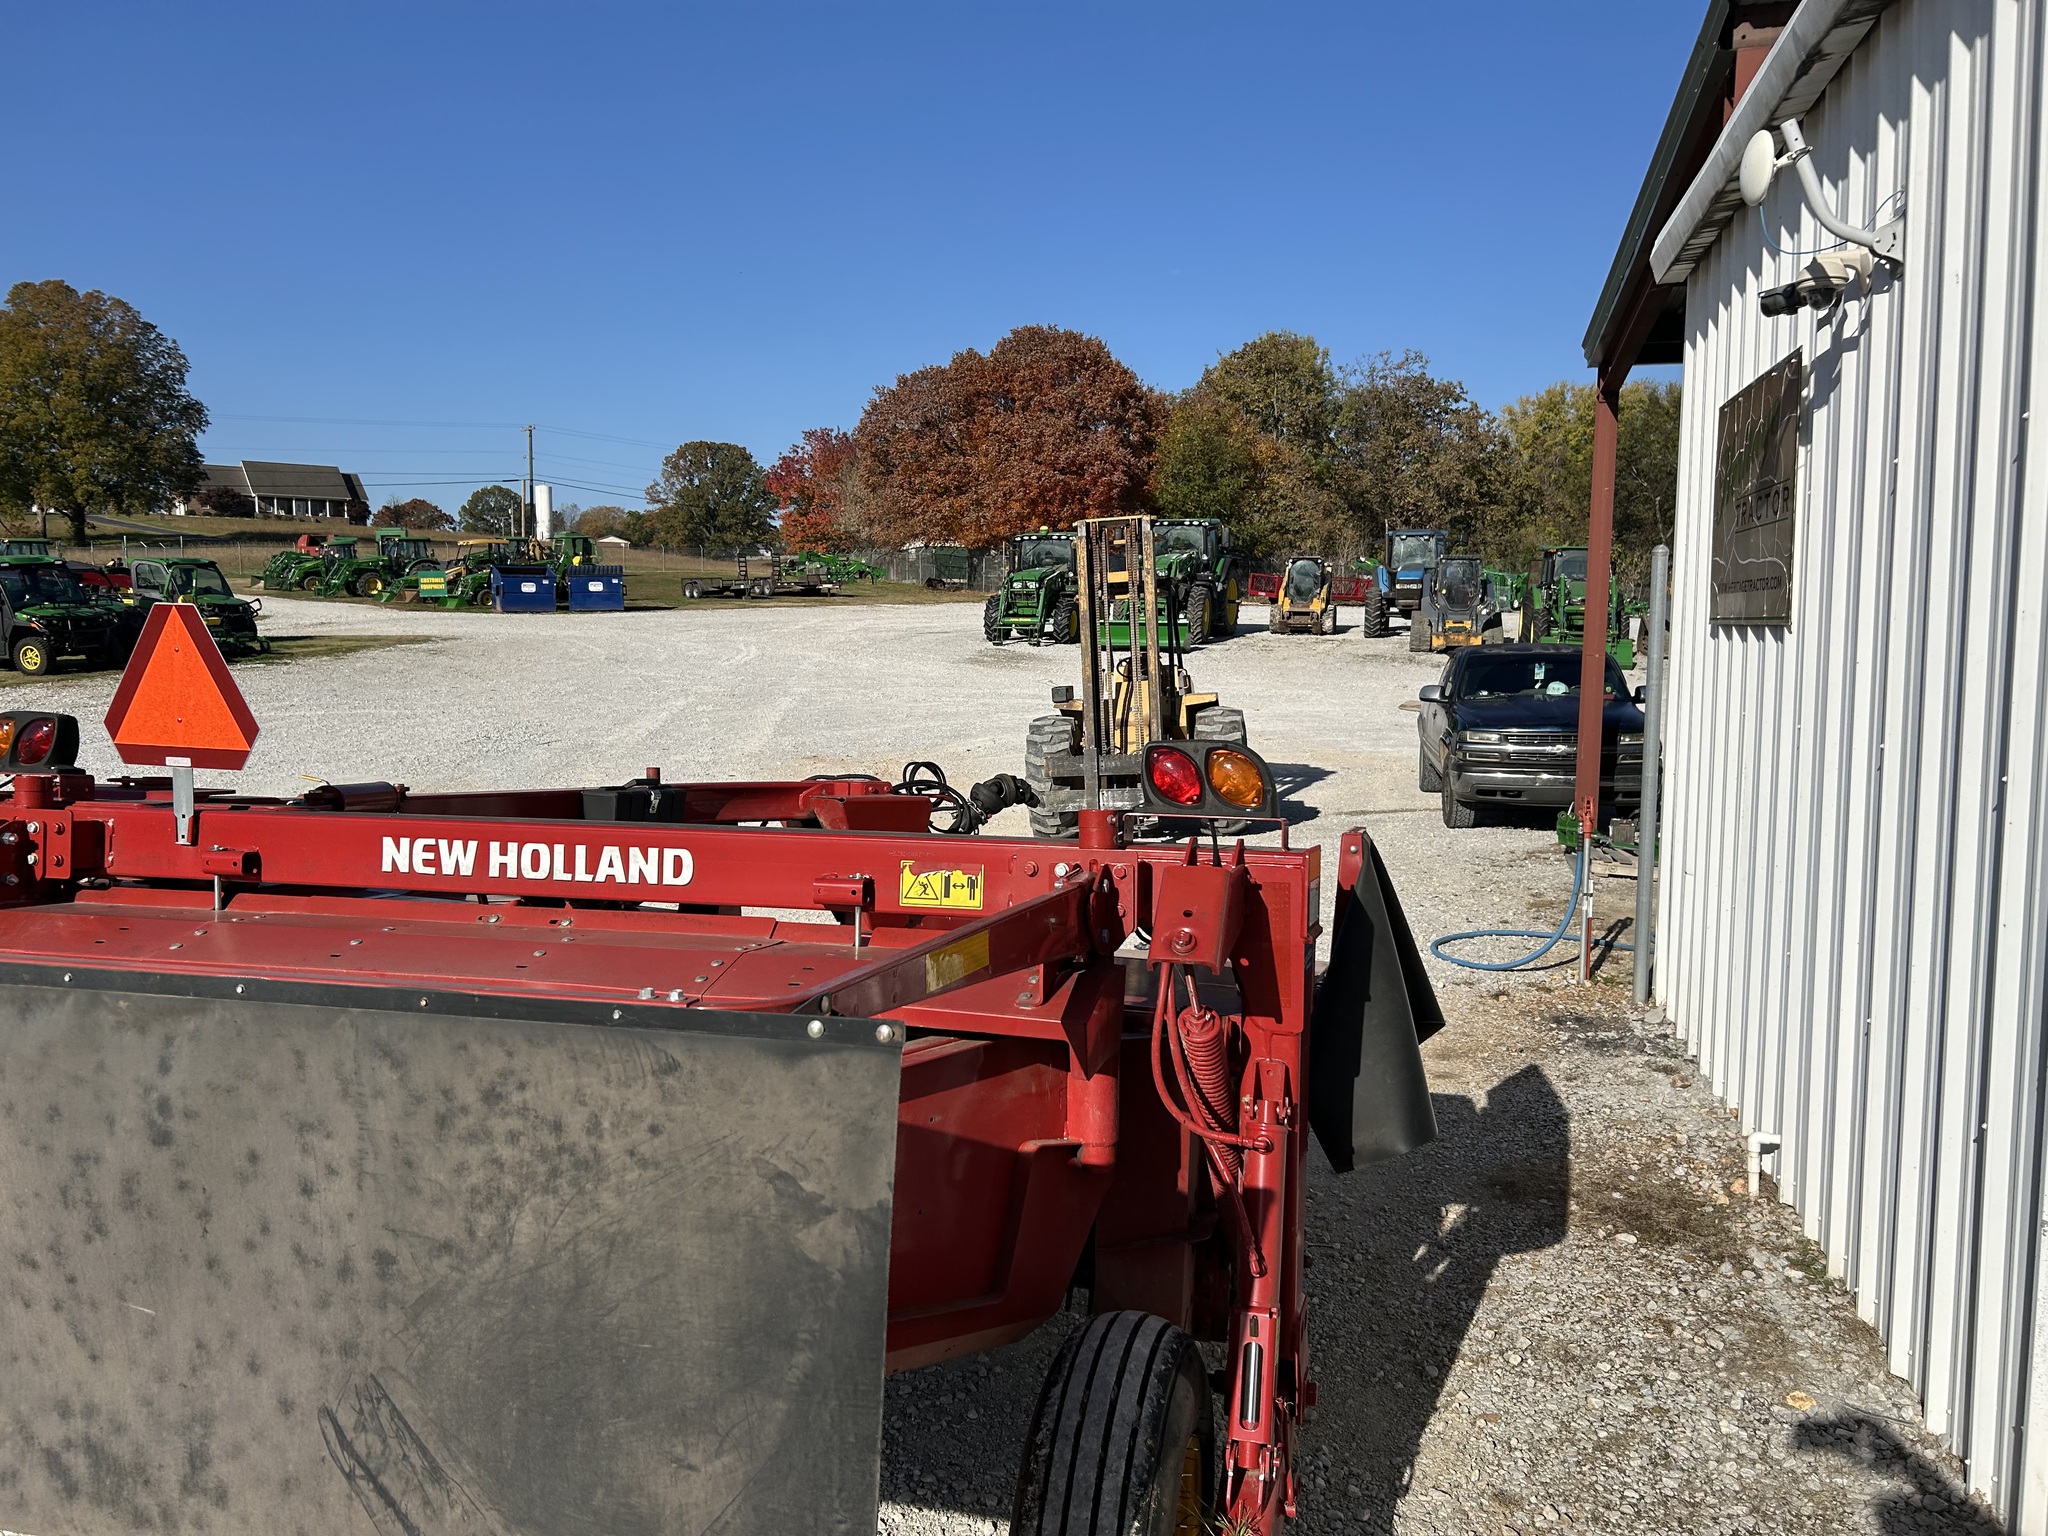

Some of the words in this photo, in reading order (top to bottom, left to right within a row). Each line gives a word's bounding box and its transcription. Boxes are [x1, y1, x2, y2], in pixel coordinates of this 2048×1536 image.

[1735, 486, 1790, 528] TRACTOR
[381, 836, 478, 876] NEW
[488, 841, 695, 886] HOLLAND
